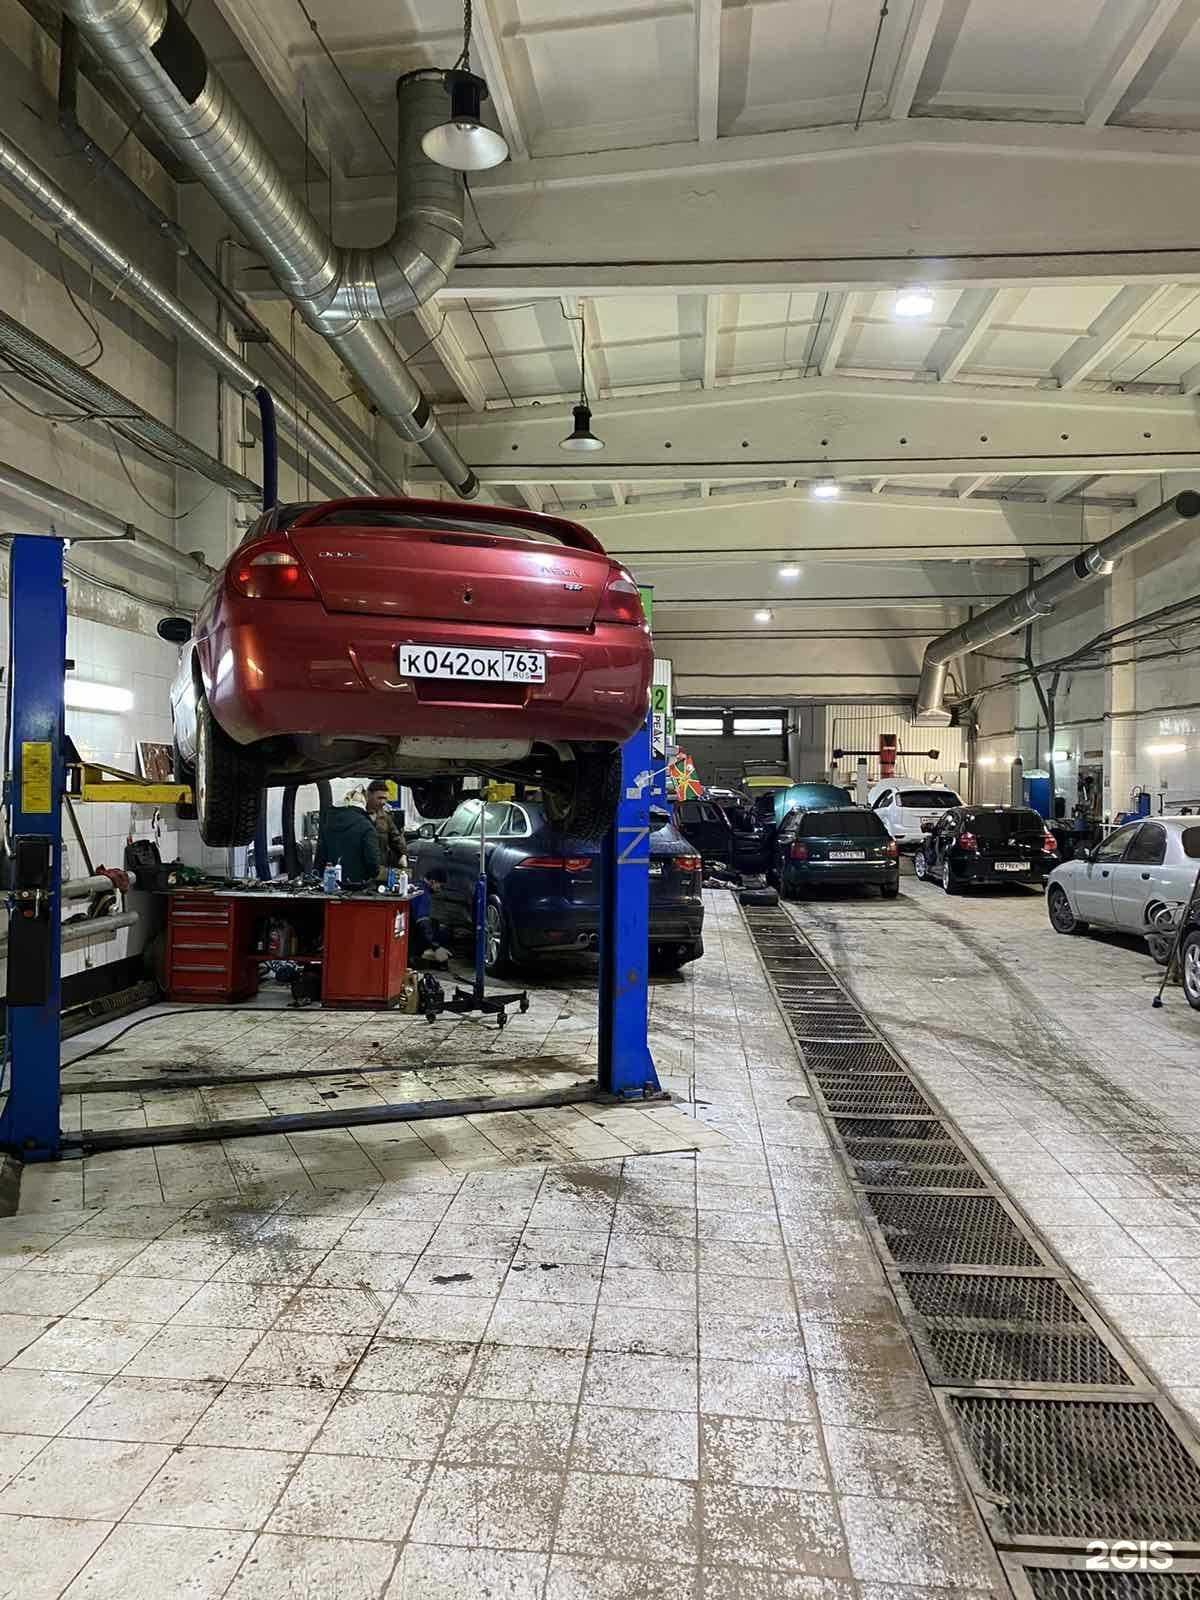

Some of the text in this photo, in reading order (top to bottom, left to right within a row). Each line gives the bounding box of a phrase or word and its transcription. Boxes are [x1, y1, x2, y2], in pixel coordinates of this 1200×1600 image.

[504, 654, 539, 673] 763
[513, 671, 530, 680] RUS
[655, 688, 665, 711] 2
